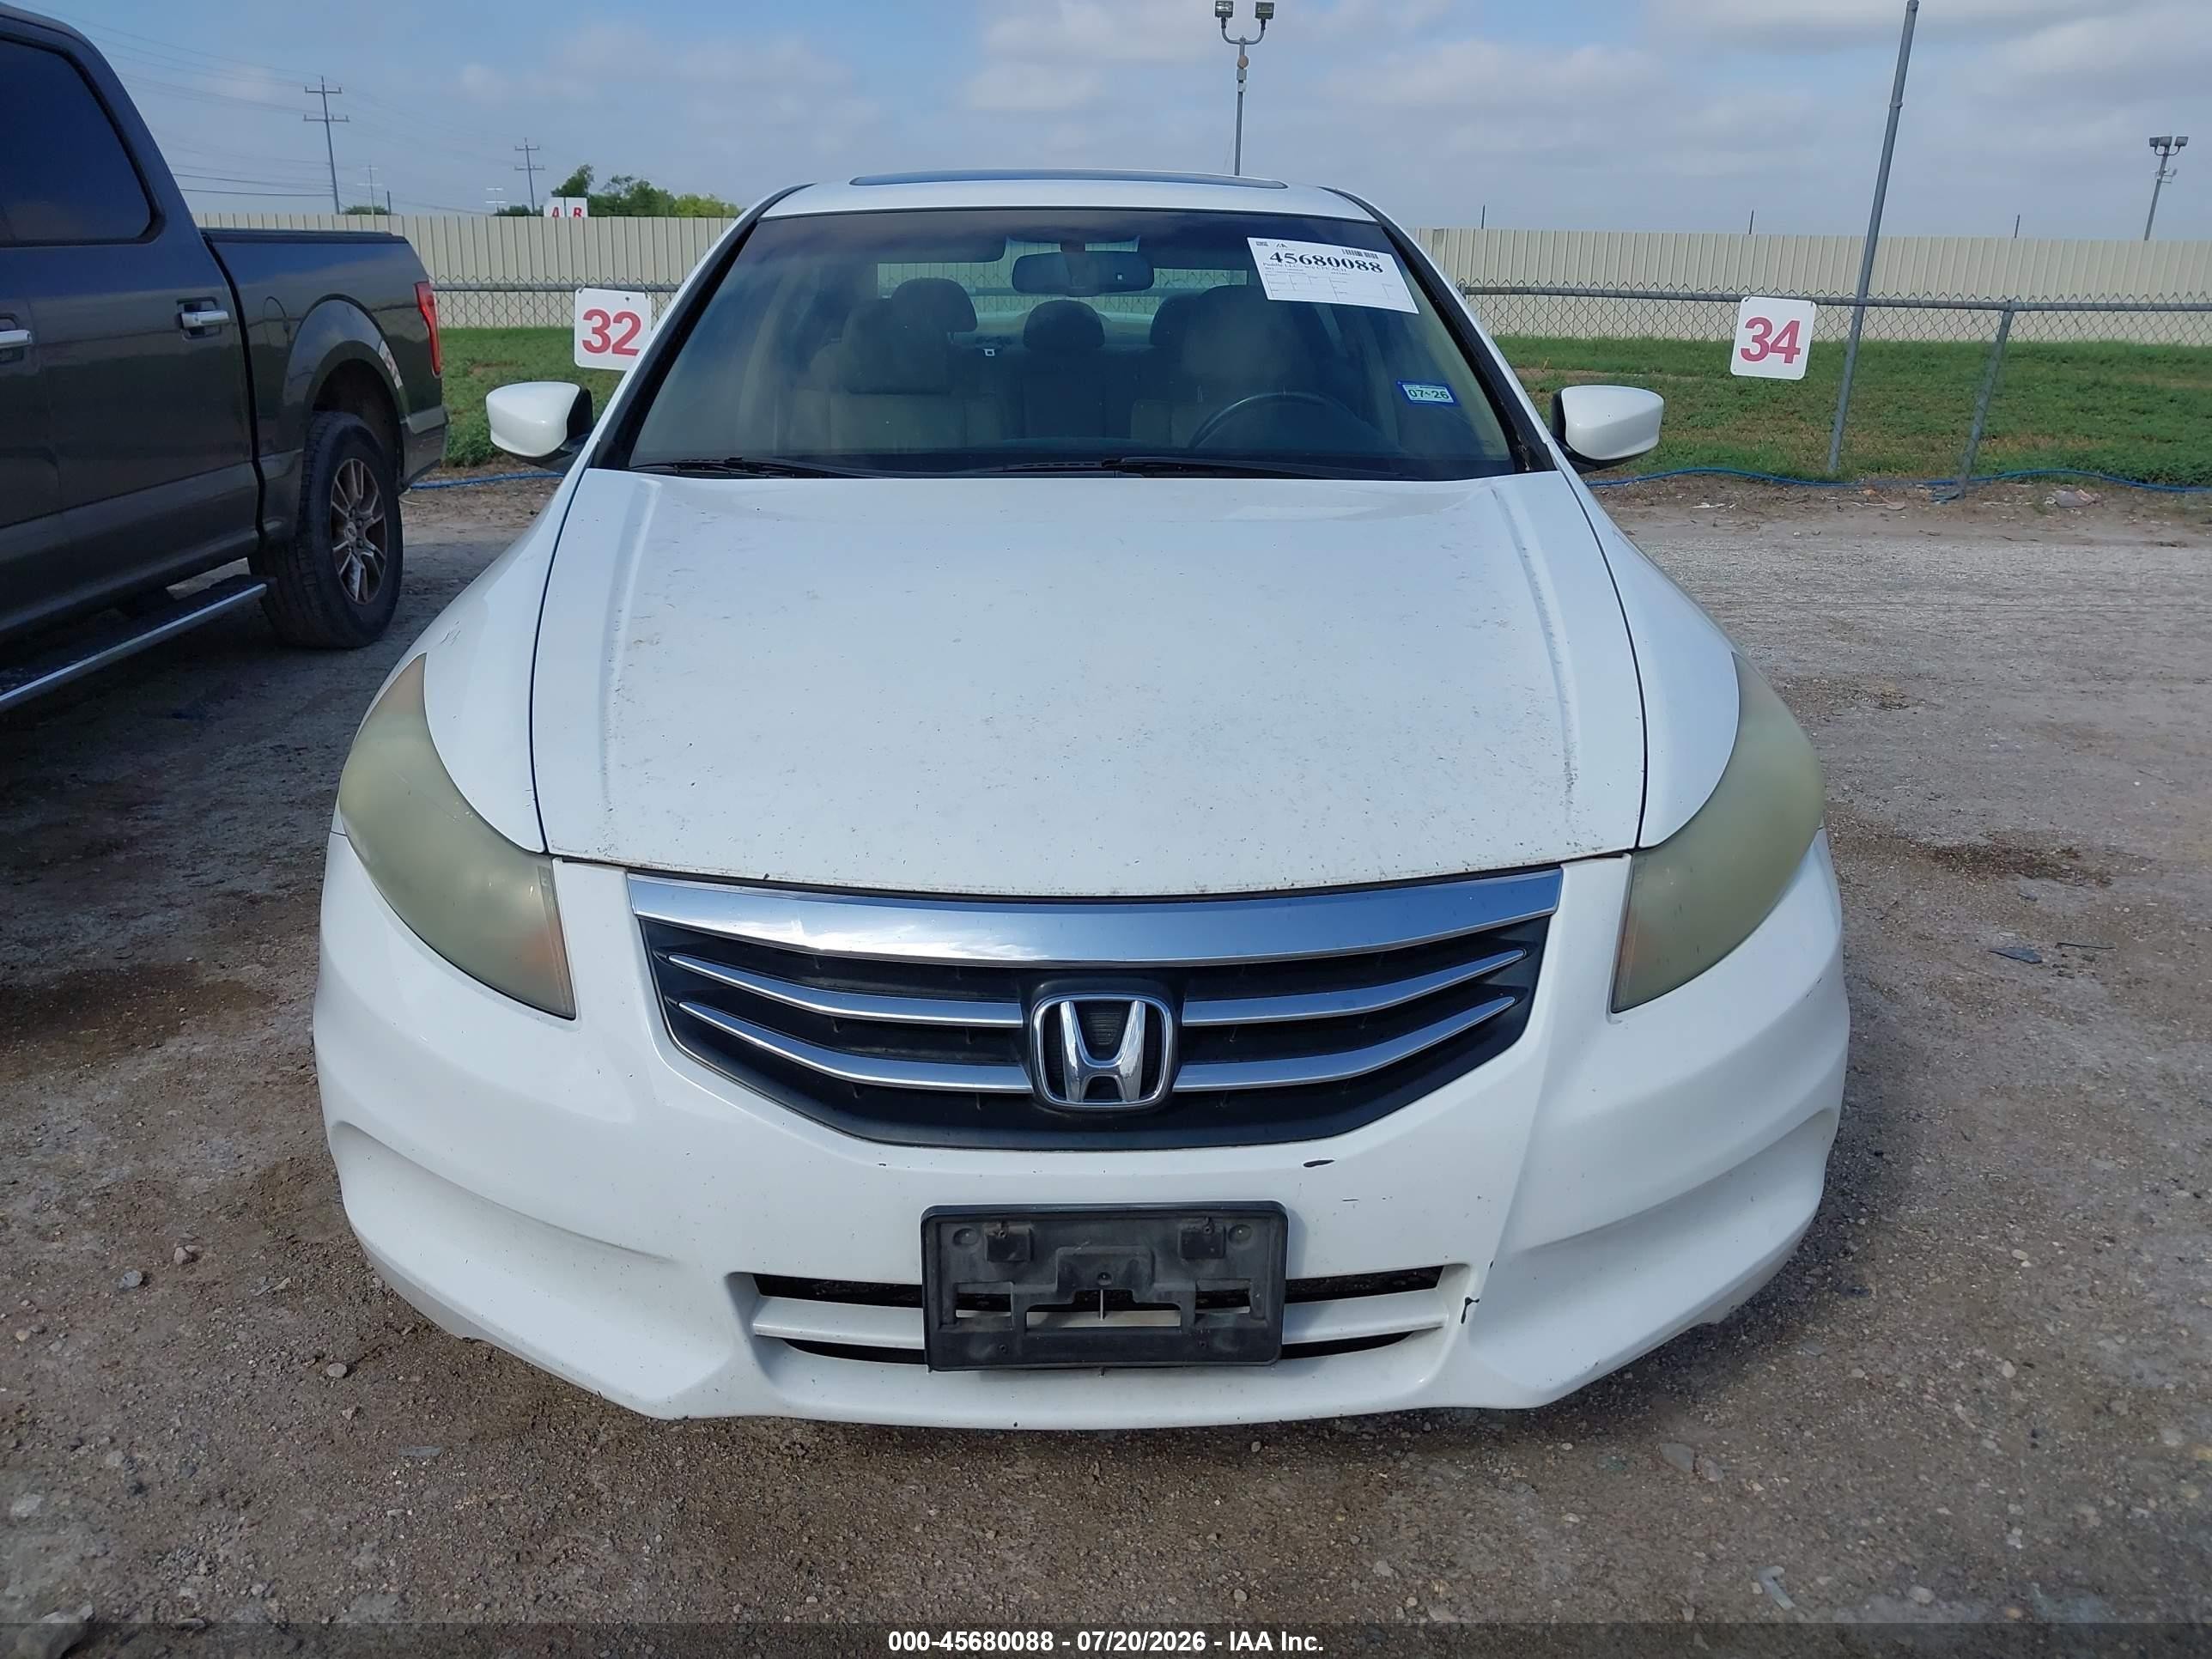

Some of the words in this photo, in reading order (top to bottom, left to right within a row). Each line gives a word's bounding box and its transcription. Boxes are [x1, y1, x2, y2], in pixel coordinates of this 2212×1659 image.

[1269, 252, 1384, 274] 45680088
[582, 308, 641, 356] 32
[1740, 317, 1802, 364] 34
[1408, 389, 1424, 398] 07
[1431, 390, 1449, 399] 26
